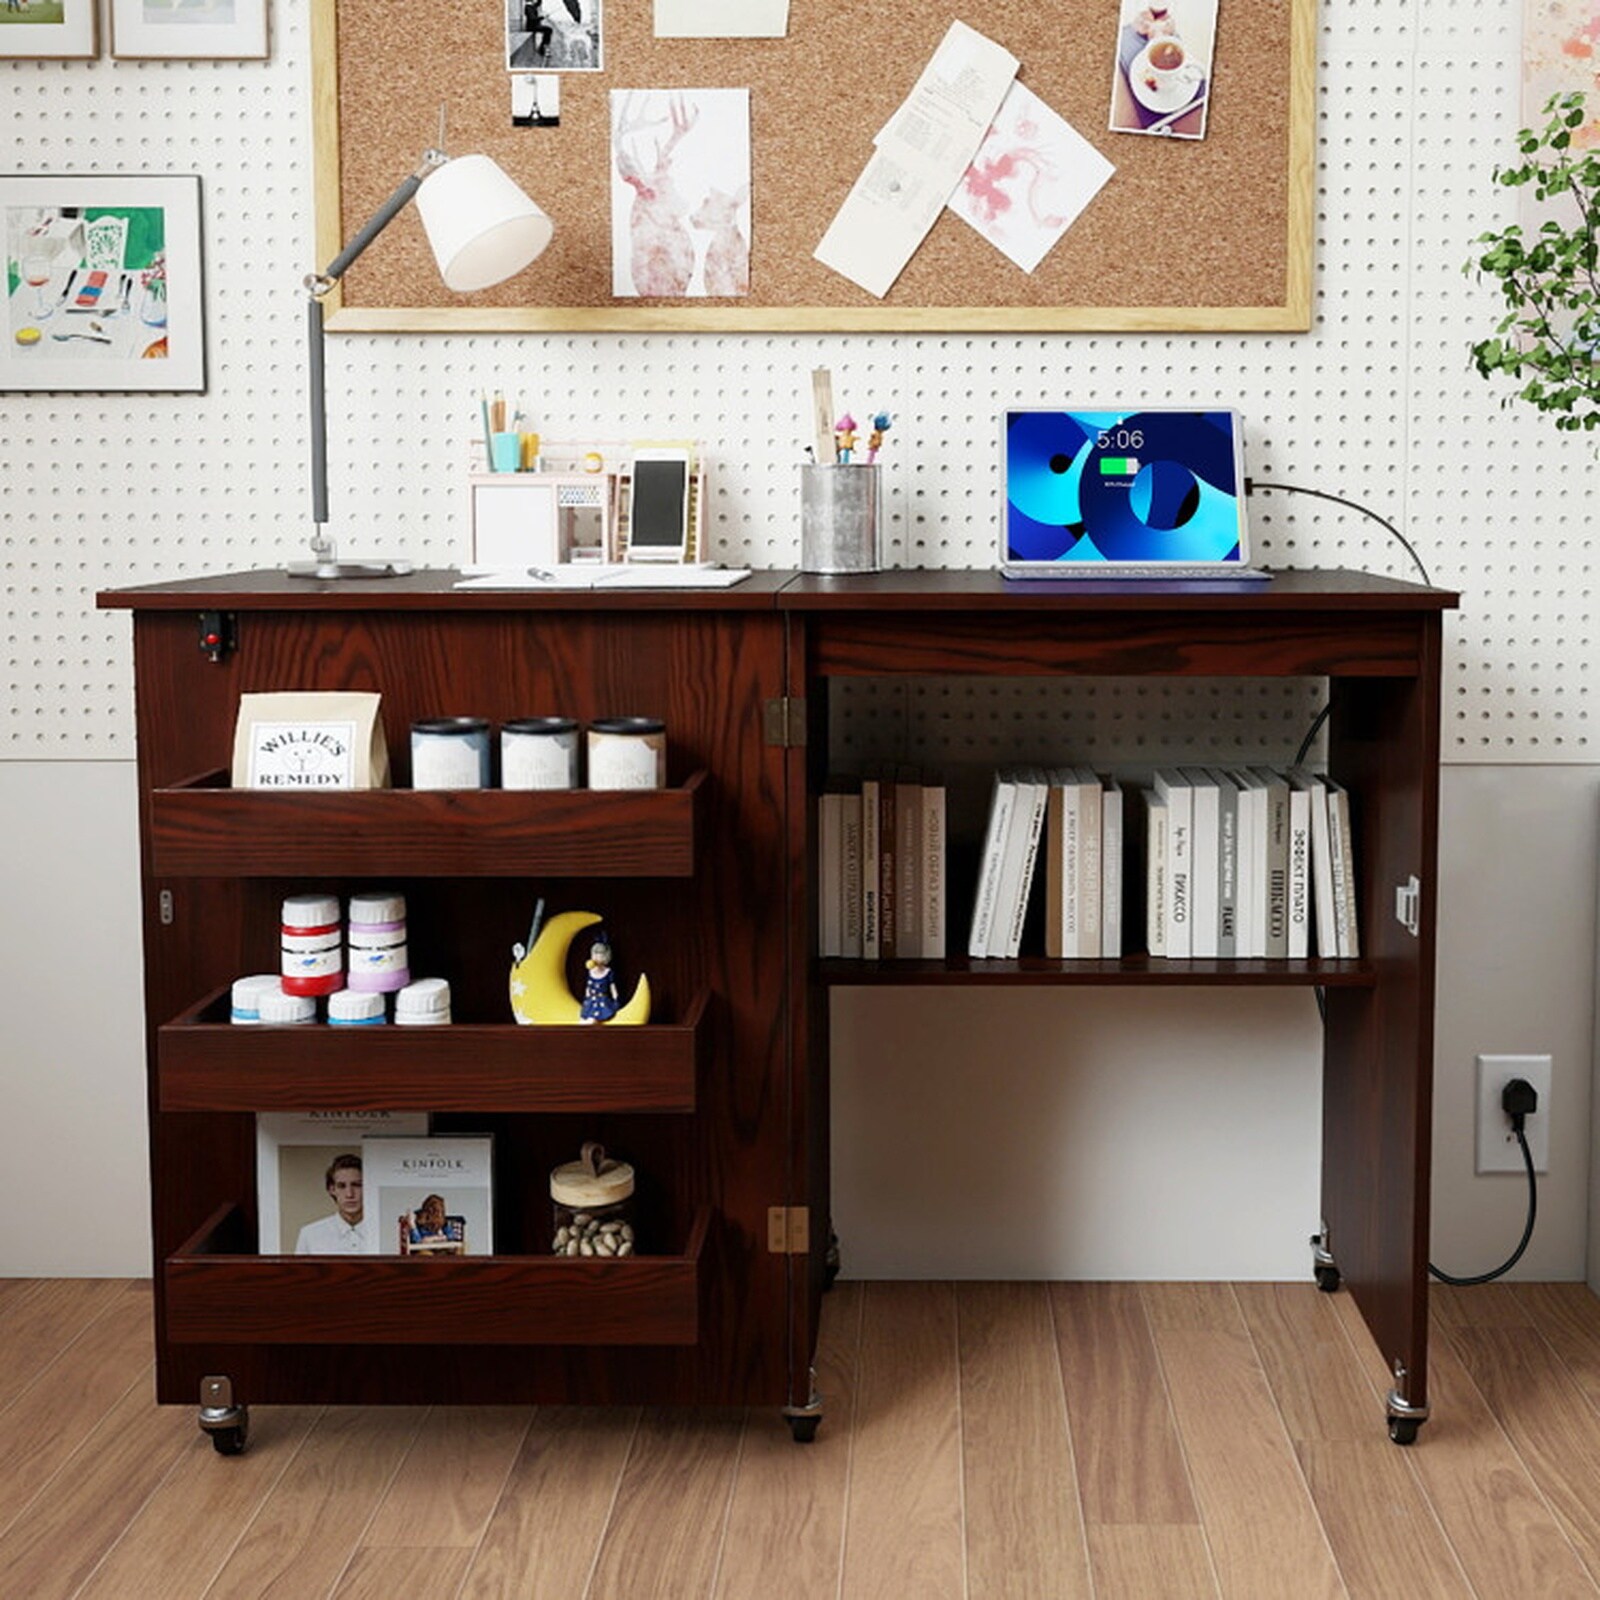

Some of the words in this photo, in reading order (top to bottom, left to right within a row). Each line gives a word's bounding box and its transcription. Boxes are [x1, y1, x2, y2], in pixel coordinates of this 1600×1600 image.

[1097, 430, 1144, 449] 5:06
[260, 730, 346, 757] WILLIE'S
[259, 774, 343, 785] REMEDY
[1293, 829, 1306, 878] ЭФФЕКТ
[1293, 882, 1305, 924] ПЛАТО
[402, 1159, 464, 1169] KINFOLK
